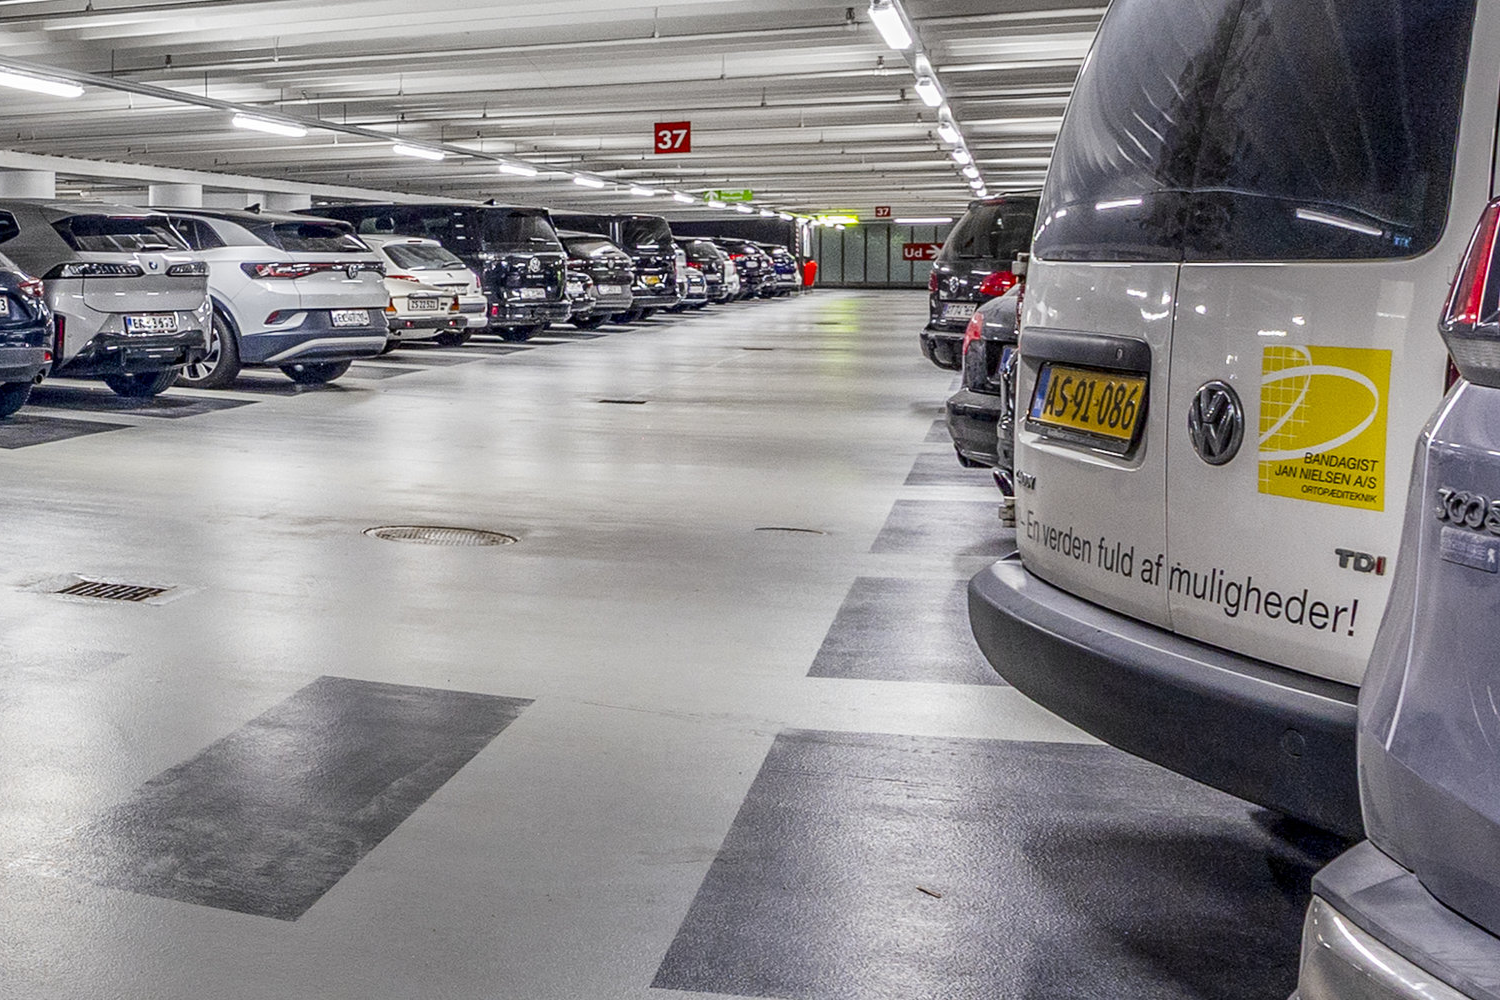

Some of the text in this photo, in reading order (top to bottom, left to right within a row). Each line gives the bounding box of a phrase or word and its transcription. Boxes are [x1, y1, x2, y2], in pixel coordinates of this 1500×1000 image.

[657, 129, 688, 150] 37
[876, 207, 890, 216] 37
[904, 247, 923, 258] Ud
[1043, 375, 1139, 430] AS 91 086
[1304, 452, 1379, 472] BANDAGIST
[1275, 465, 1377, 489] JAN NIELSEN A/S
[1301, 485, 1378, 503] ORTOPÆDITEKNIK
[1334, 547, 1388, 577] TDI
[1027, 510, 1040, 543] En
[1043, 526, 1092, 564] verden
[1098, 537, 1134, 578] fuld
[1140, 553, 1164, 586] af
[1169, 563, 1359, 637] muligheder!
